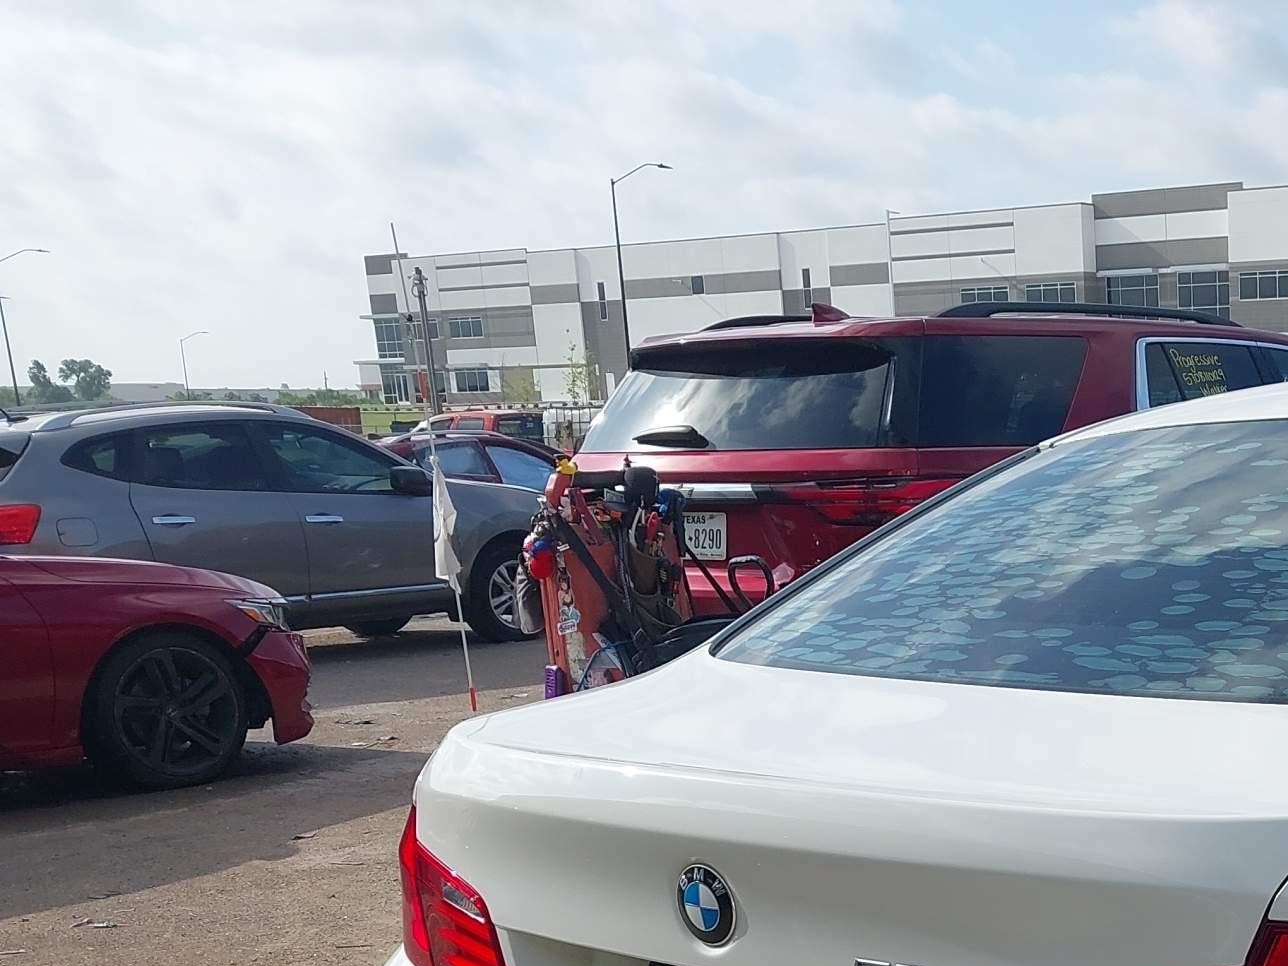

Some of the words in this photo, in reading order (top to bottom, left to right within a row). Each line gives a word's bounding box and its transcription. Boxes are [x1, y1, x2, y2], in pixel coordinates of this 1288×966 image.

[1169, 348, 1222, 373] Progressive
[686, 515, 706, 524] EXAS
[694, 528, 722, 550] 8290
[679, 867, 726, 897] BMW
